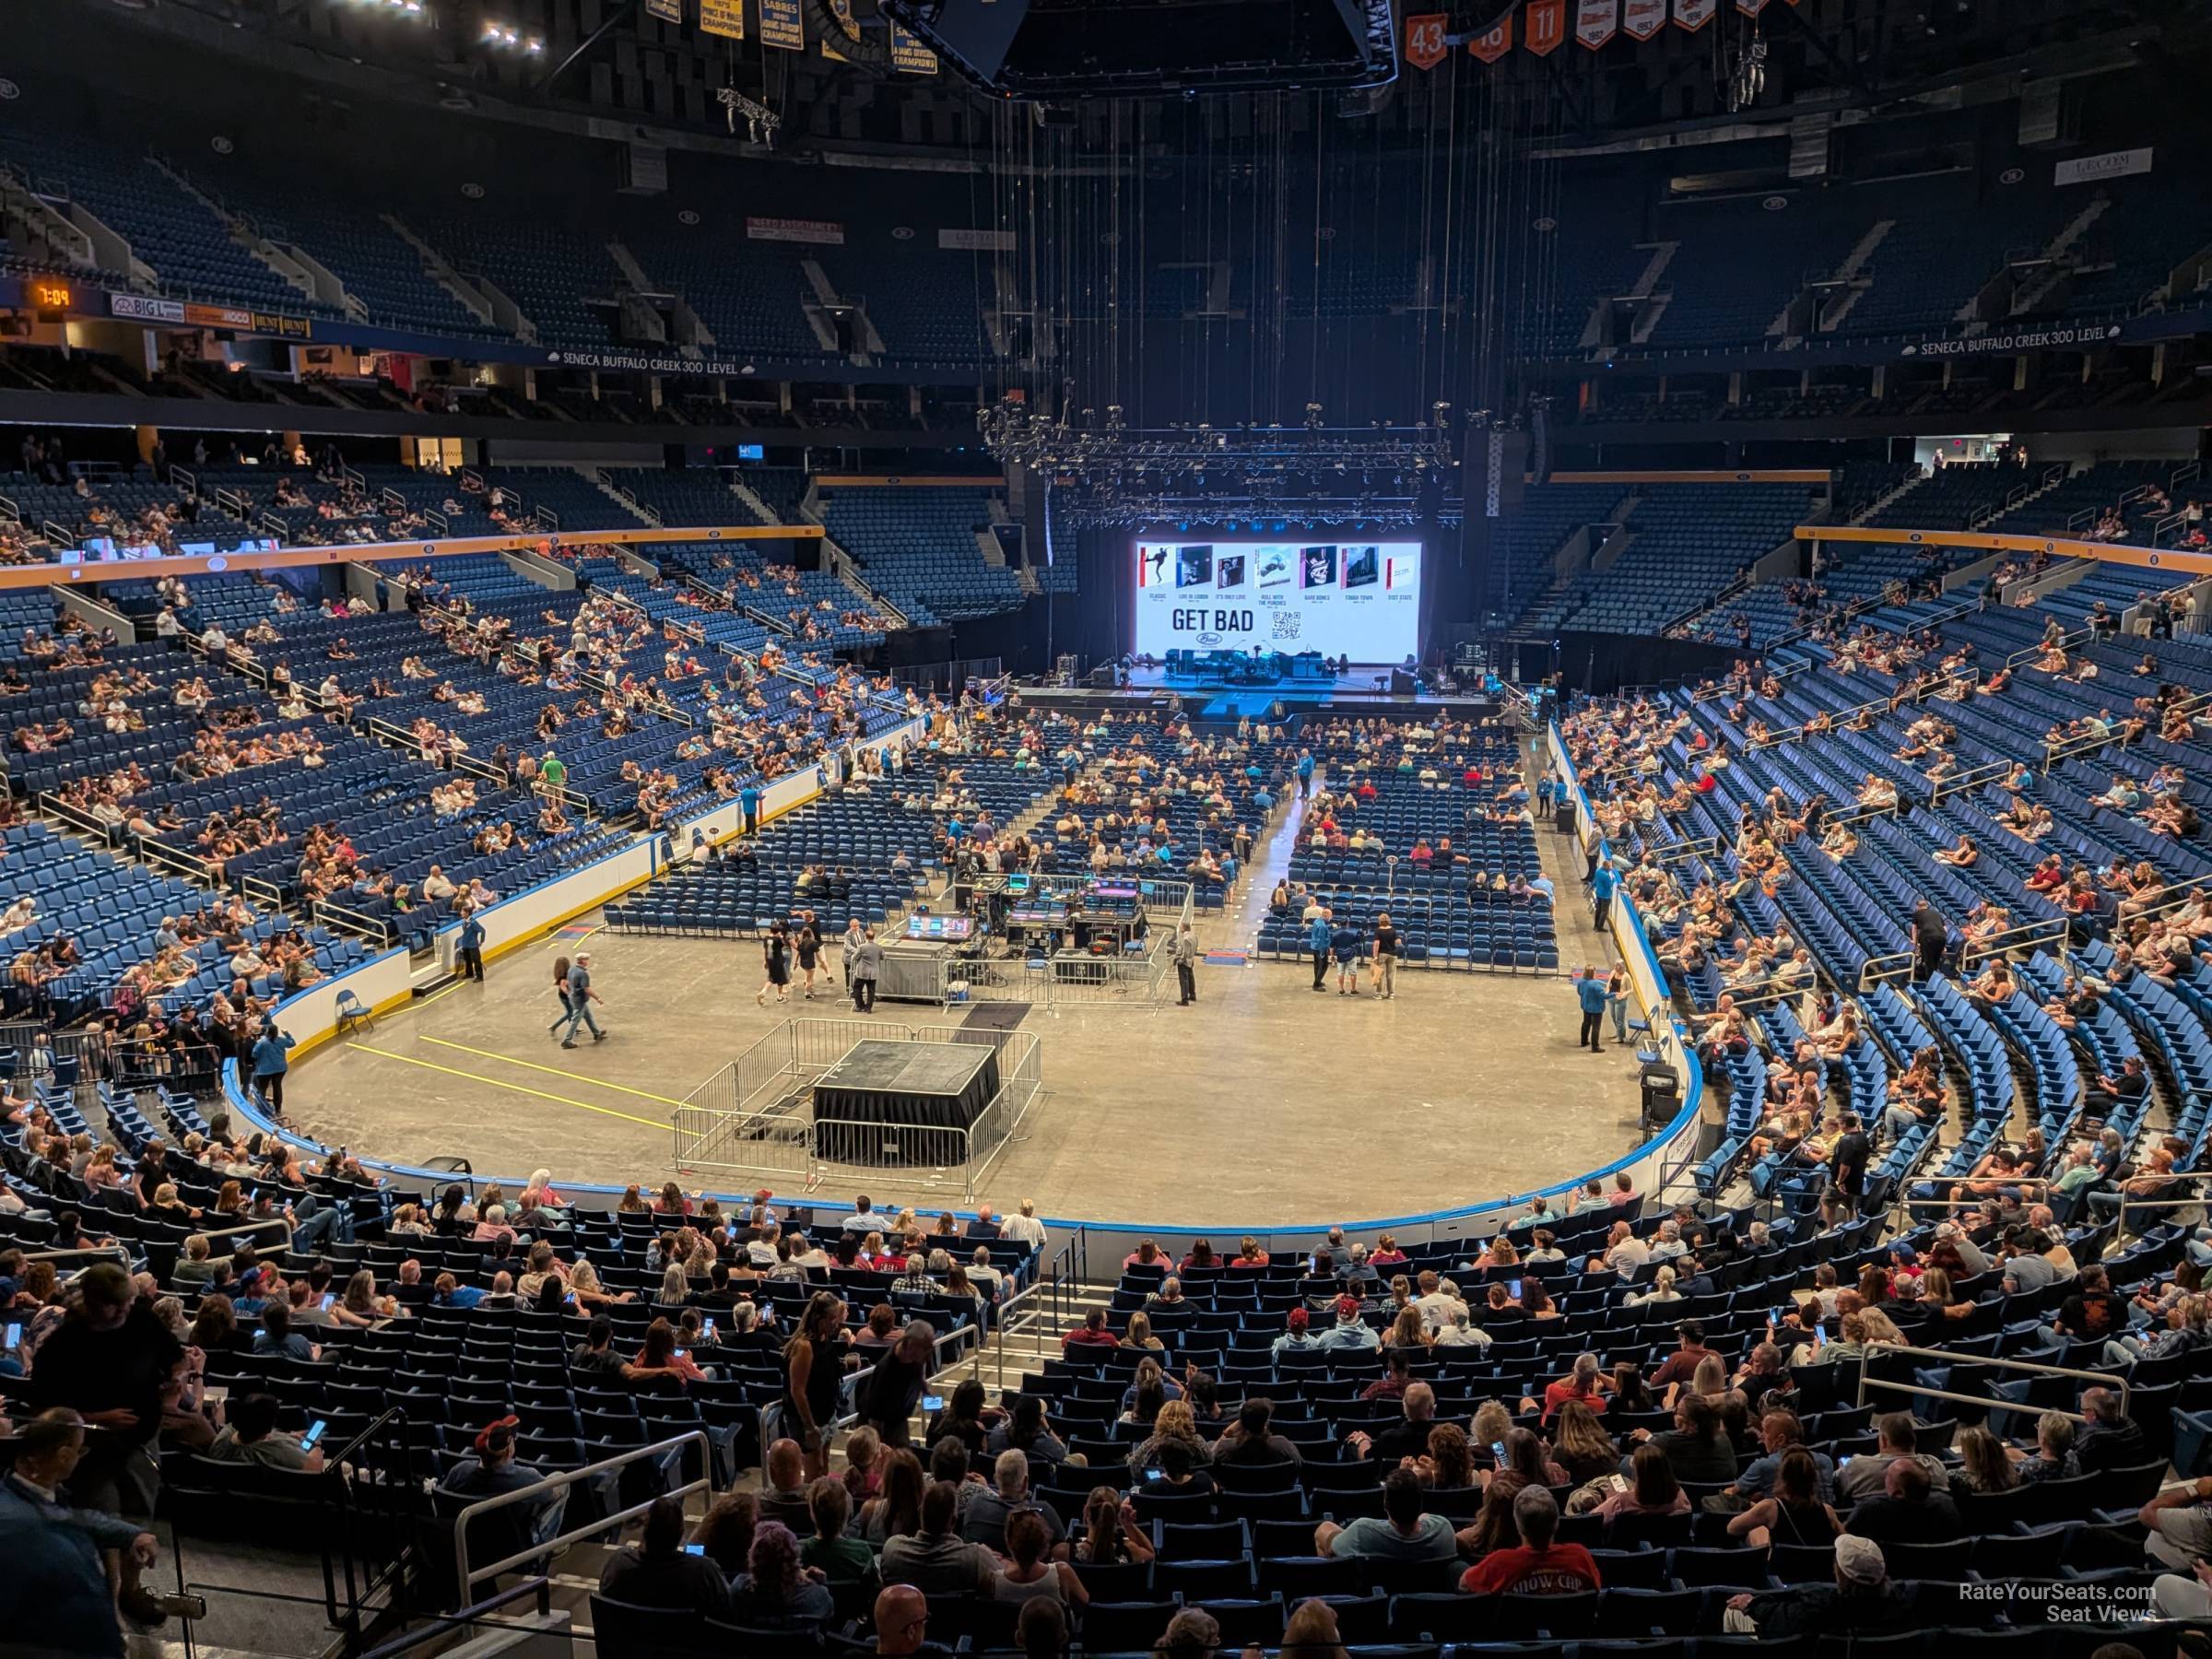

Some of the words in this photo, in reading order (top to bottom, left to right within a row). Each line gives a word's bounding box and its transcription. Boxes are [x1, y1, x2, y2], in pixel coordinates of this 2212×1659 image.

[764, 0, 797, 14] SABRES
[1535, 8, 1555, 40] 11
[1411, 22, 1442, 53] 43
[39, 288, 70, 306] 7:09
[134, 300, 155, 315] BIG
[256, 313, 278, 328] HUNT
[284, 318, 305, 332] HUNT
[1921, 342, 1964, 355] SENECA
[1968, 337, 2012, 352] BUFFALO
[2016, 333, 2050, 347] CREEK
[2051, 329, 2074, 345] 300
[2077, 326, 2106, 342] LEVEL
[563, 352, 600, 366] SENECA
[603, 356, 648, 370] BUFFALO
[650, 359, 681, 371] CREEK
[683, 361, 703, 373] 300
[707, 363, 738, 374] LEVEL
[1172, 608, 1209, 630] GET
[1215, 609, 1253, 631] BAD
[1558, 1574, 1582, 1591] CAP
